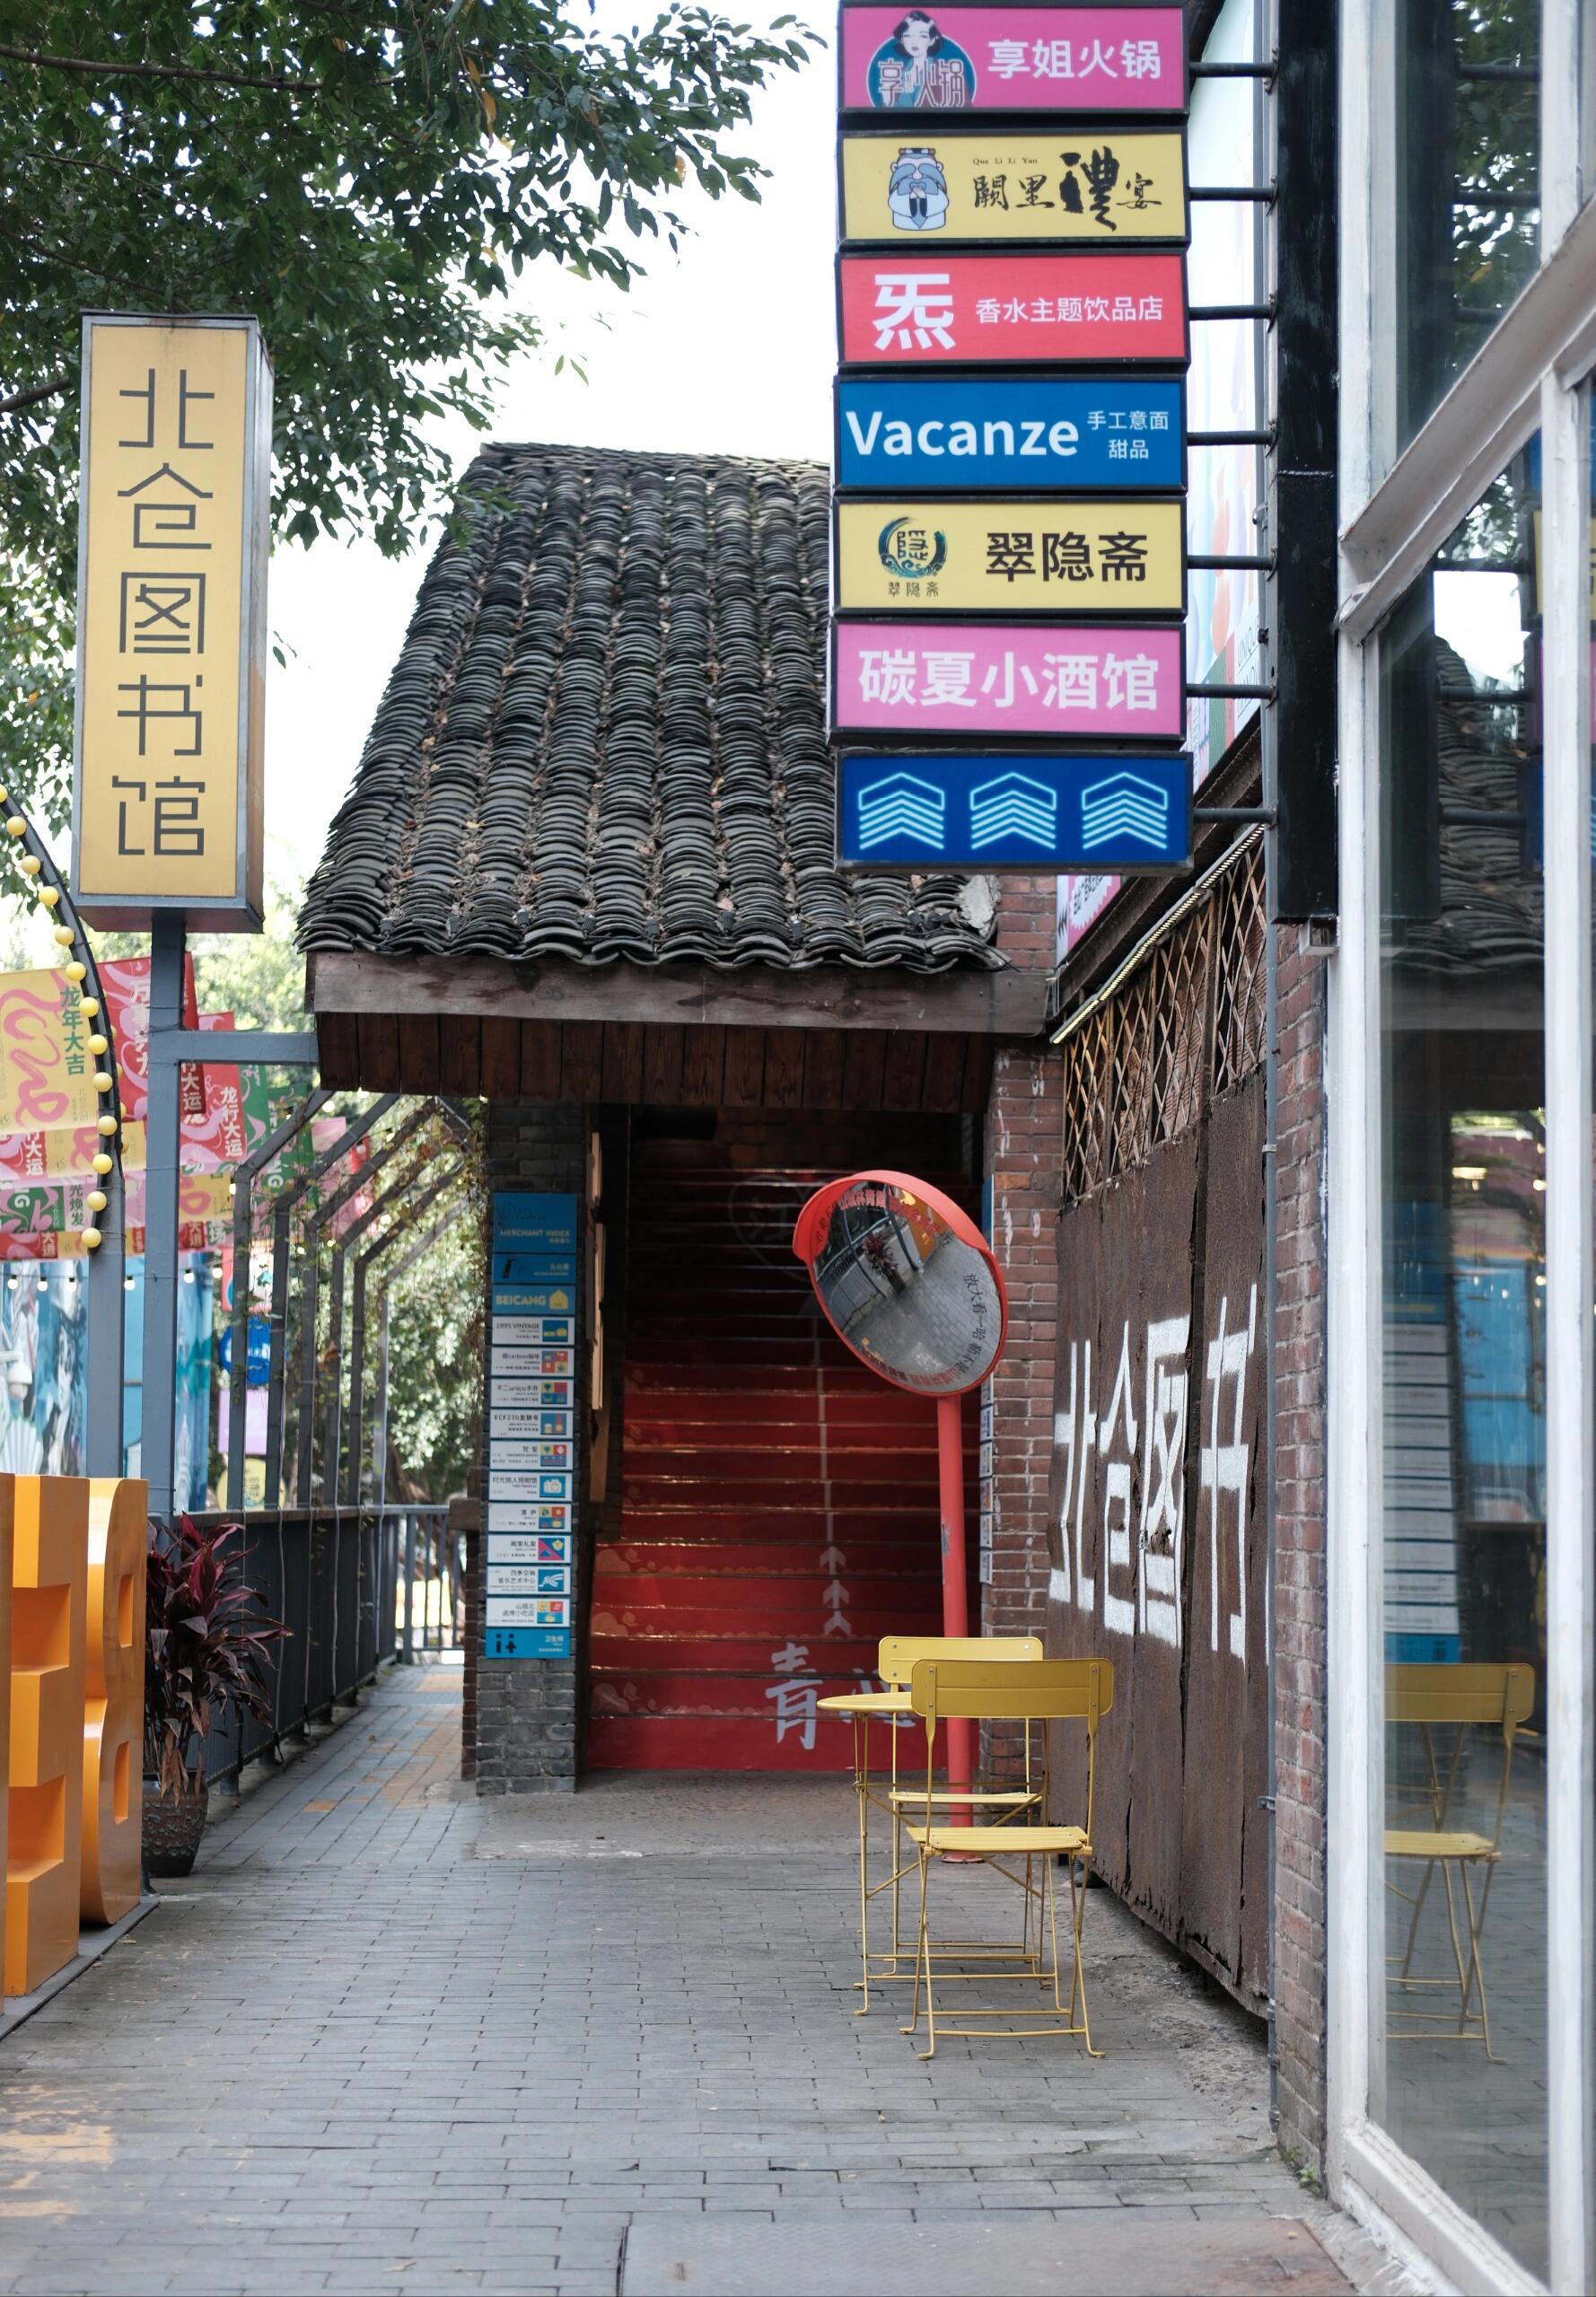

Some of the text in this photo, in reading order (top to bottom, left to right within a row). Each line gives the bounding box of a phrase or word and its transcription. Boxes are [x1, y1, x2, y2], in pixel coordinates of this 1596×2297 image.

[987, 39, 1162, 79] 享姐火锅
[972, 157, 988, 166] Que
[975, 295, 1163, 324] 香水主题饮品店
[846, 410, 1079, 457] Vacanze
[1087, 410, 1169, 431] 手工意面
[1108, 439, 1149, 460] 甜品
[986, 530, 1148, 583] 翠隐斋
[111, 367, 215, 856] 北仓图书馆
[858, 648, 1160, 711] 碳夏小酒馆
[60, 986, 85, 1076] 龙年大吉
[220, 1086, 243, 1158] 龙行大运
[500, 1229, 571, 1237] MERCHANT INDEX
[495, 1295, 547, 1306] BEICANG
